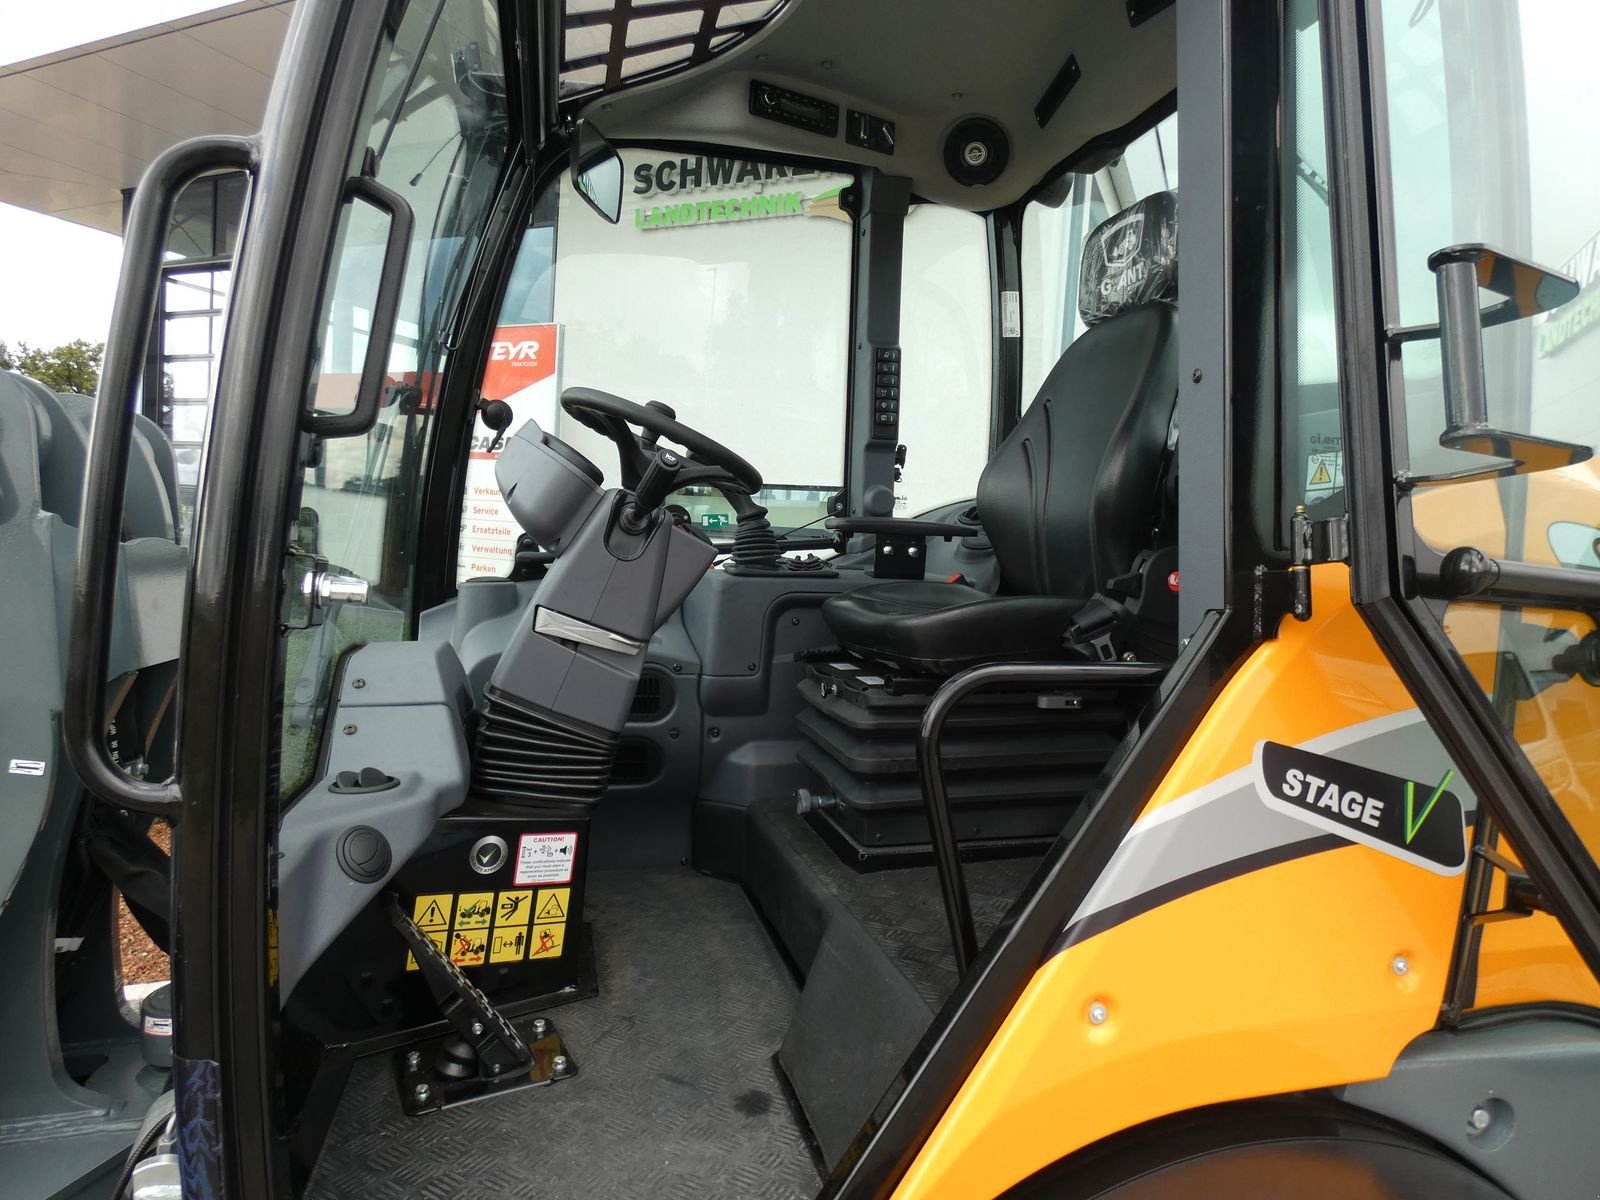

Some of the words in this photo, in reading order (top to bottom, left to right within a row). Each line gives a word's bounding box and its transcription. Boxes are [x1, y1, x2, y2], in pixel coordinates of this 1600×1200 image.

[635, 191, 801, 229] LANDTECHNIK
[491, 341, 539, 361] EYR
[473, 506, 499, 516] Service
[472, 525, 511, 536] Ersatzteile
[471, 544, 513, 556] Verwaltung
[470, 563, 496, 573] Parken
[1282, 768, 1384, 828] STAGE
[1404, 769, 1454, 845] V
